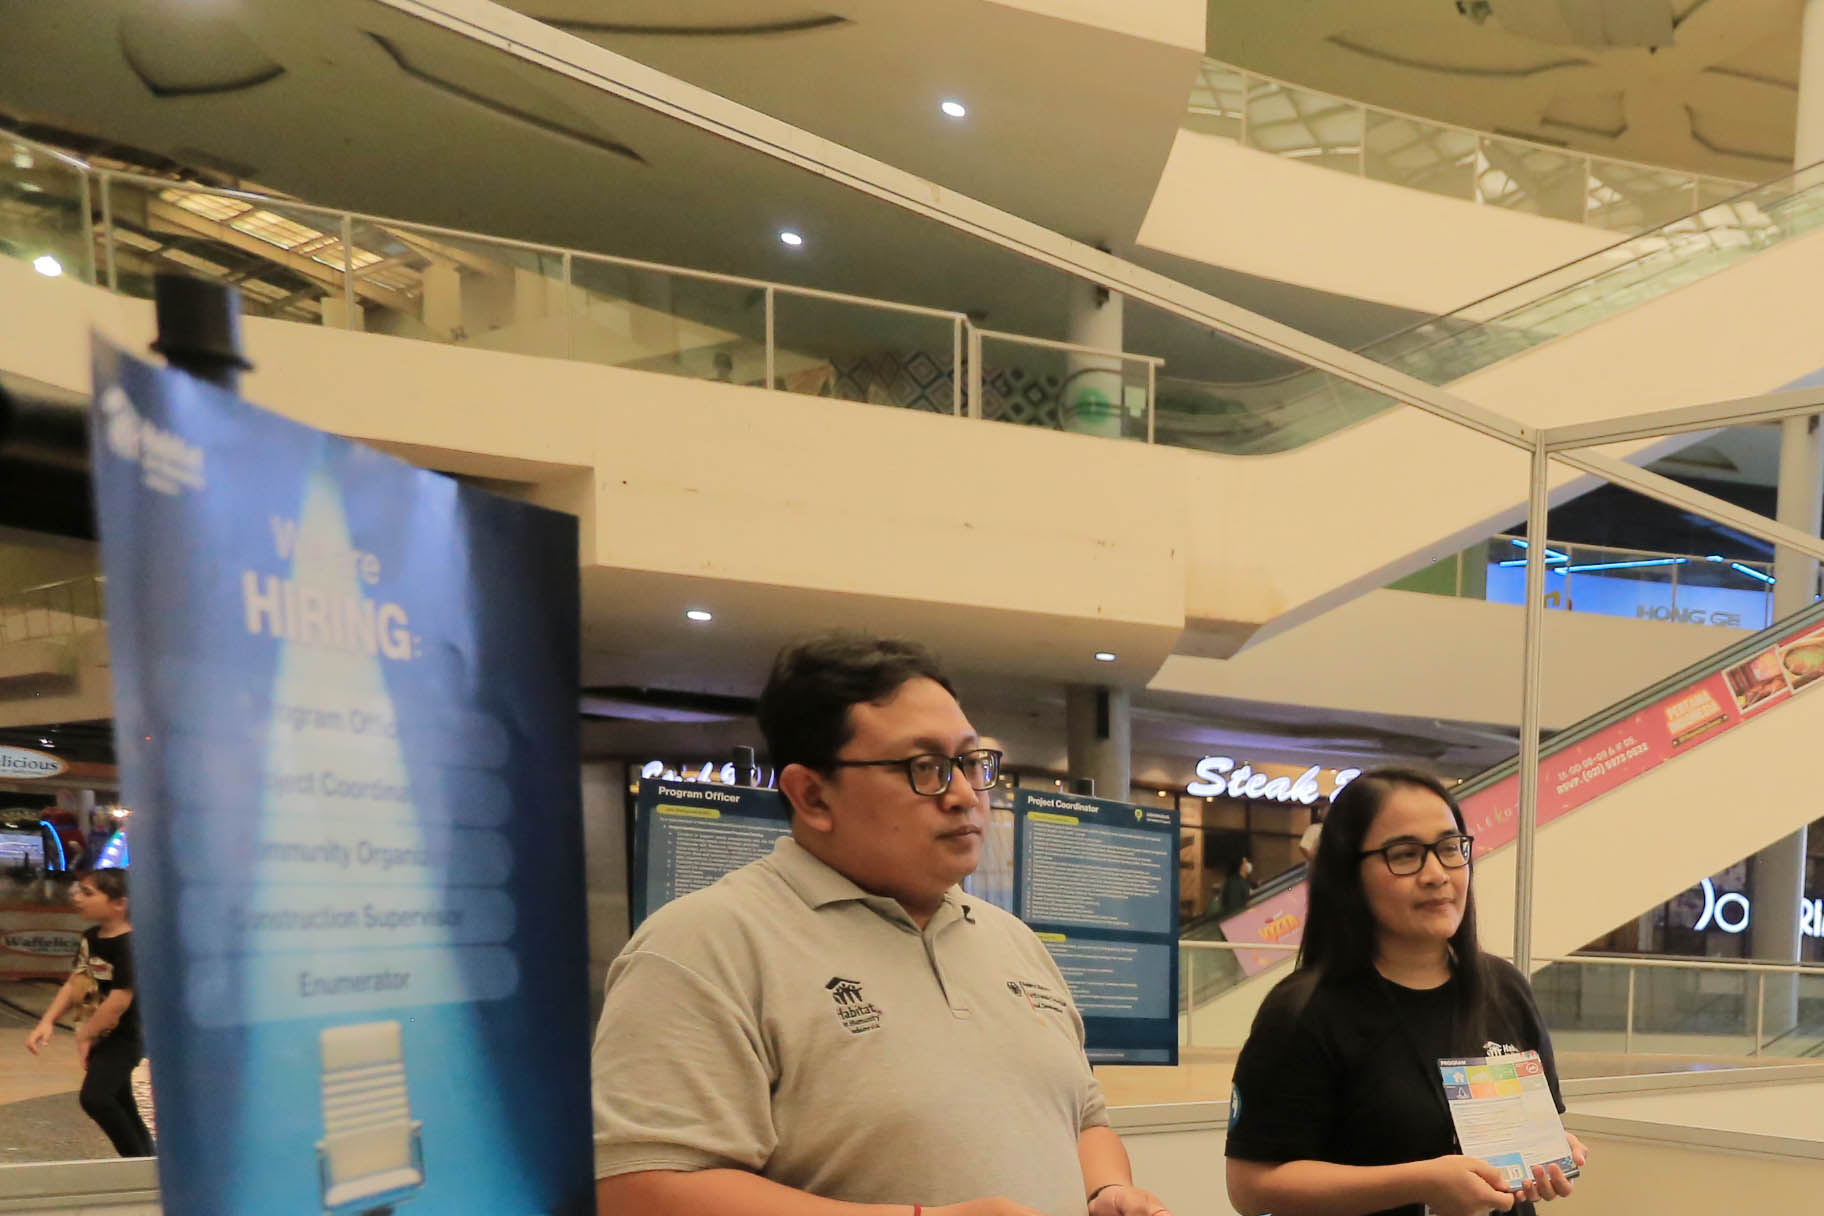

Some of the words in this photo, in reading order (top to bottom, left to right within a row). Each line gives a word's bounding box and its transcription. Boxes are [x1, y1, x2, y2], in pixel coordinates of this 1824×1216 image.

[0, 754, 59, 772] licious
[1187, 756, 1321, 805] Steak
[658, 785, 702, 800] Program
[704, 791, 741, 804] Officer
[1027, 795, 1054, 810] Project
[1055, 799, 1099, 813] Coordinator
[300, 968, 412, 998] Enumerator
